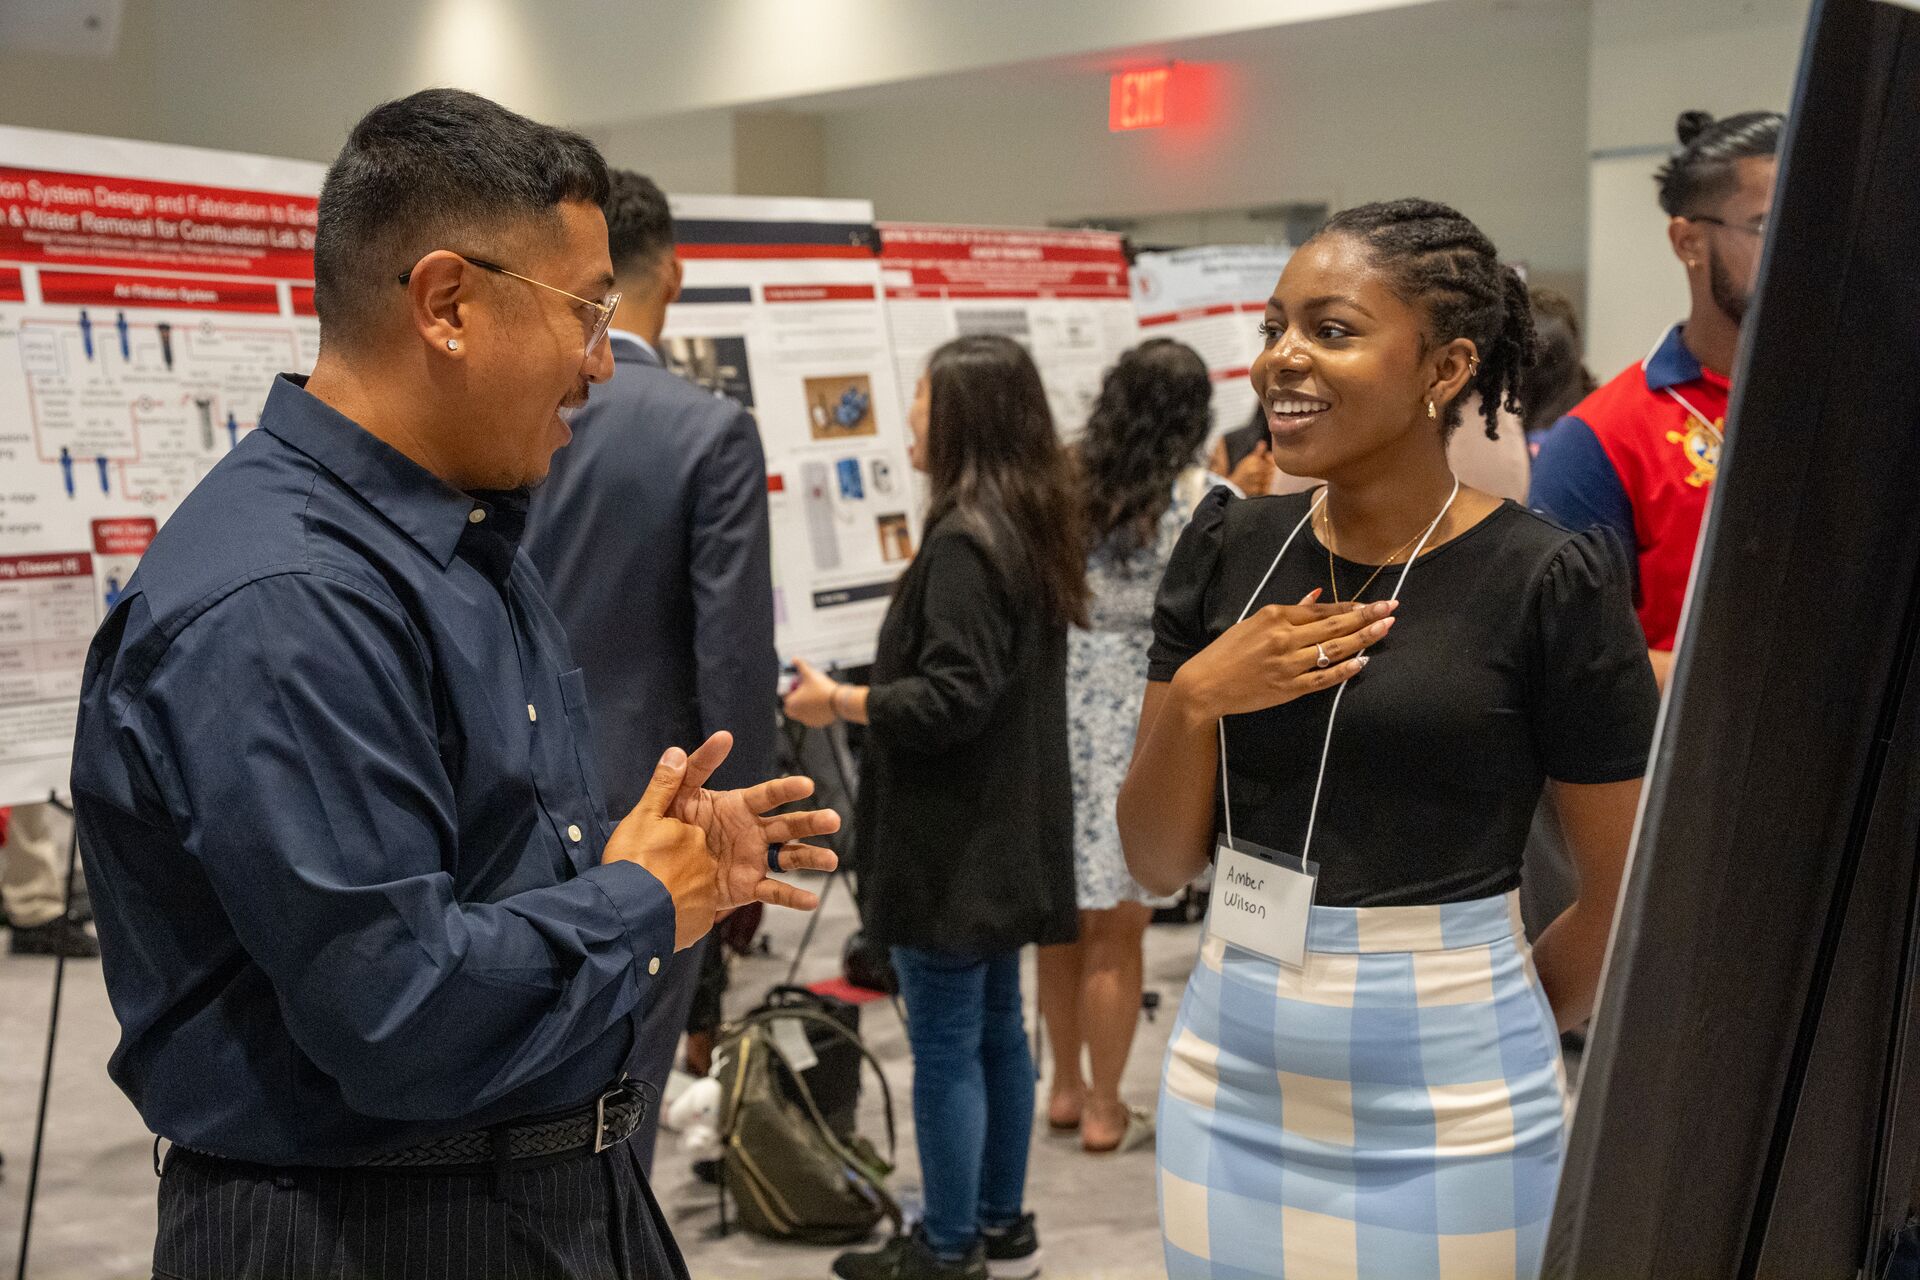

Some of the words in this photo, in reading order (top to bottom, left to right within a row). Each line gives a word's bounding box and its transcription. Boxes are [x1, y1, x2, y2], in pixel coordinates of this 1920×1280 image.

[1121, 71, 1168, 128] EXIT
[0, 180, 25, 199] on
[27, 179, 94, 207] System
[94, 185, 153, 215] Design
[155, 194, 186, 215] and
[187, 194, 269, 222] Fabrication
[270, 203, 286, 223] to
[8, 204, 26, 227] &
[25, 206, 79, 231] Water
[80, 210, 155, 237] Removal
[155, 217, 179, 239] for
[179, 219, 268, 246] Combustion
[269, 227, 298, 249] Lab
[1226, 865, 1264, 891] Amber
[1223, 891, 1266, 919] Wilson
